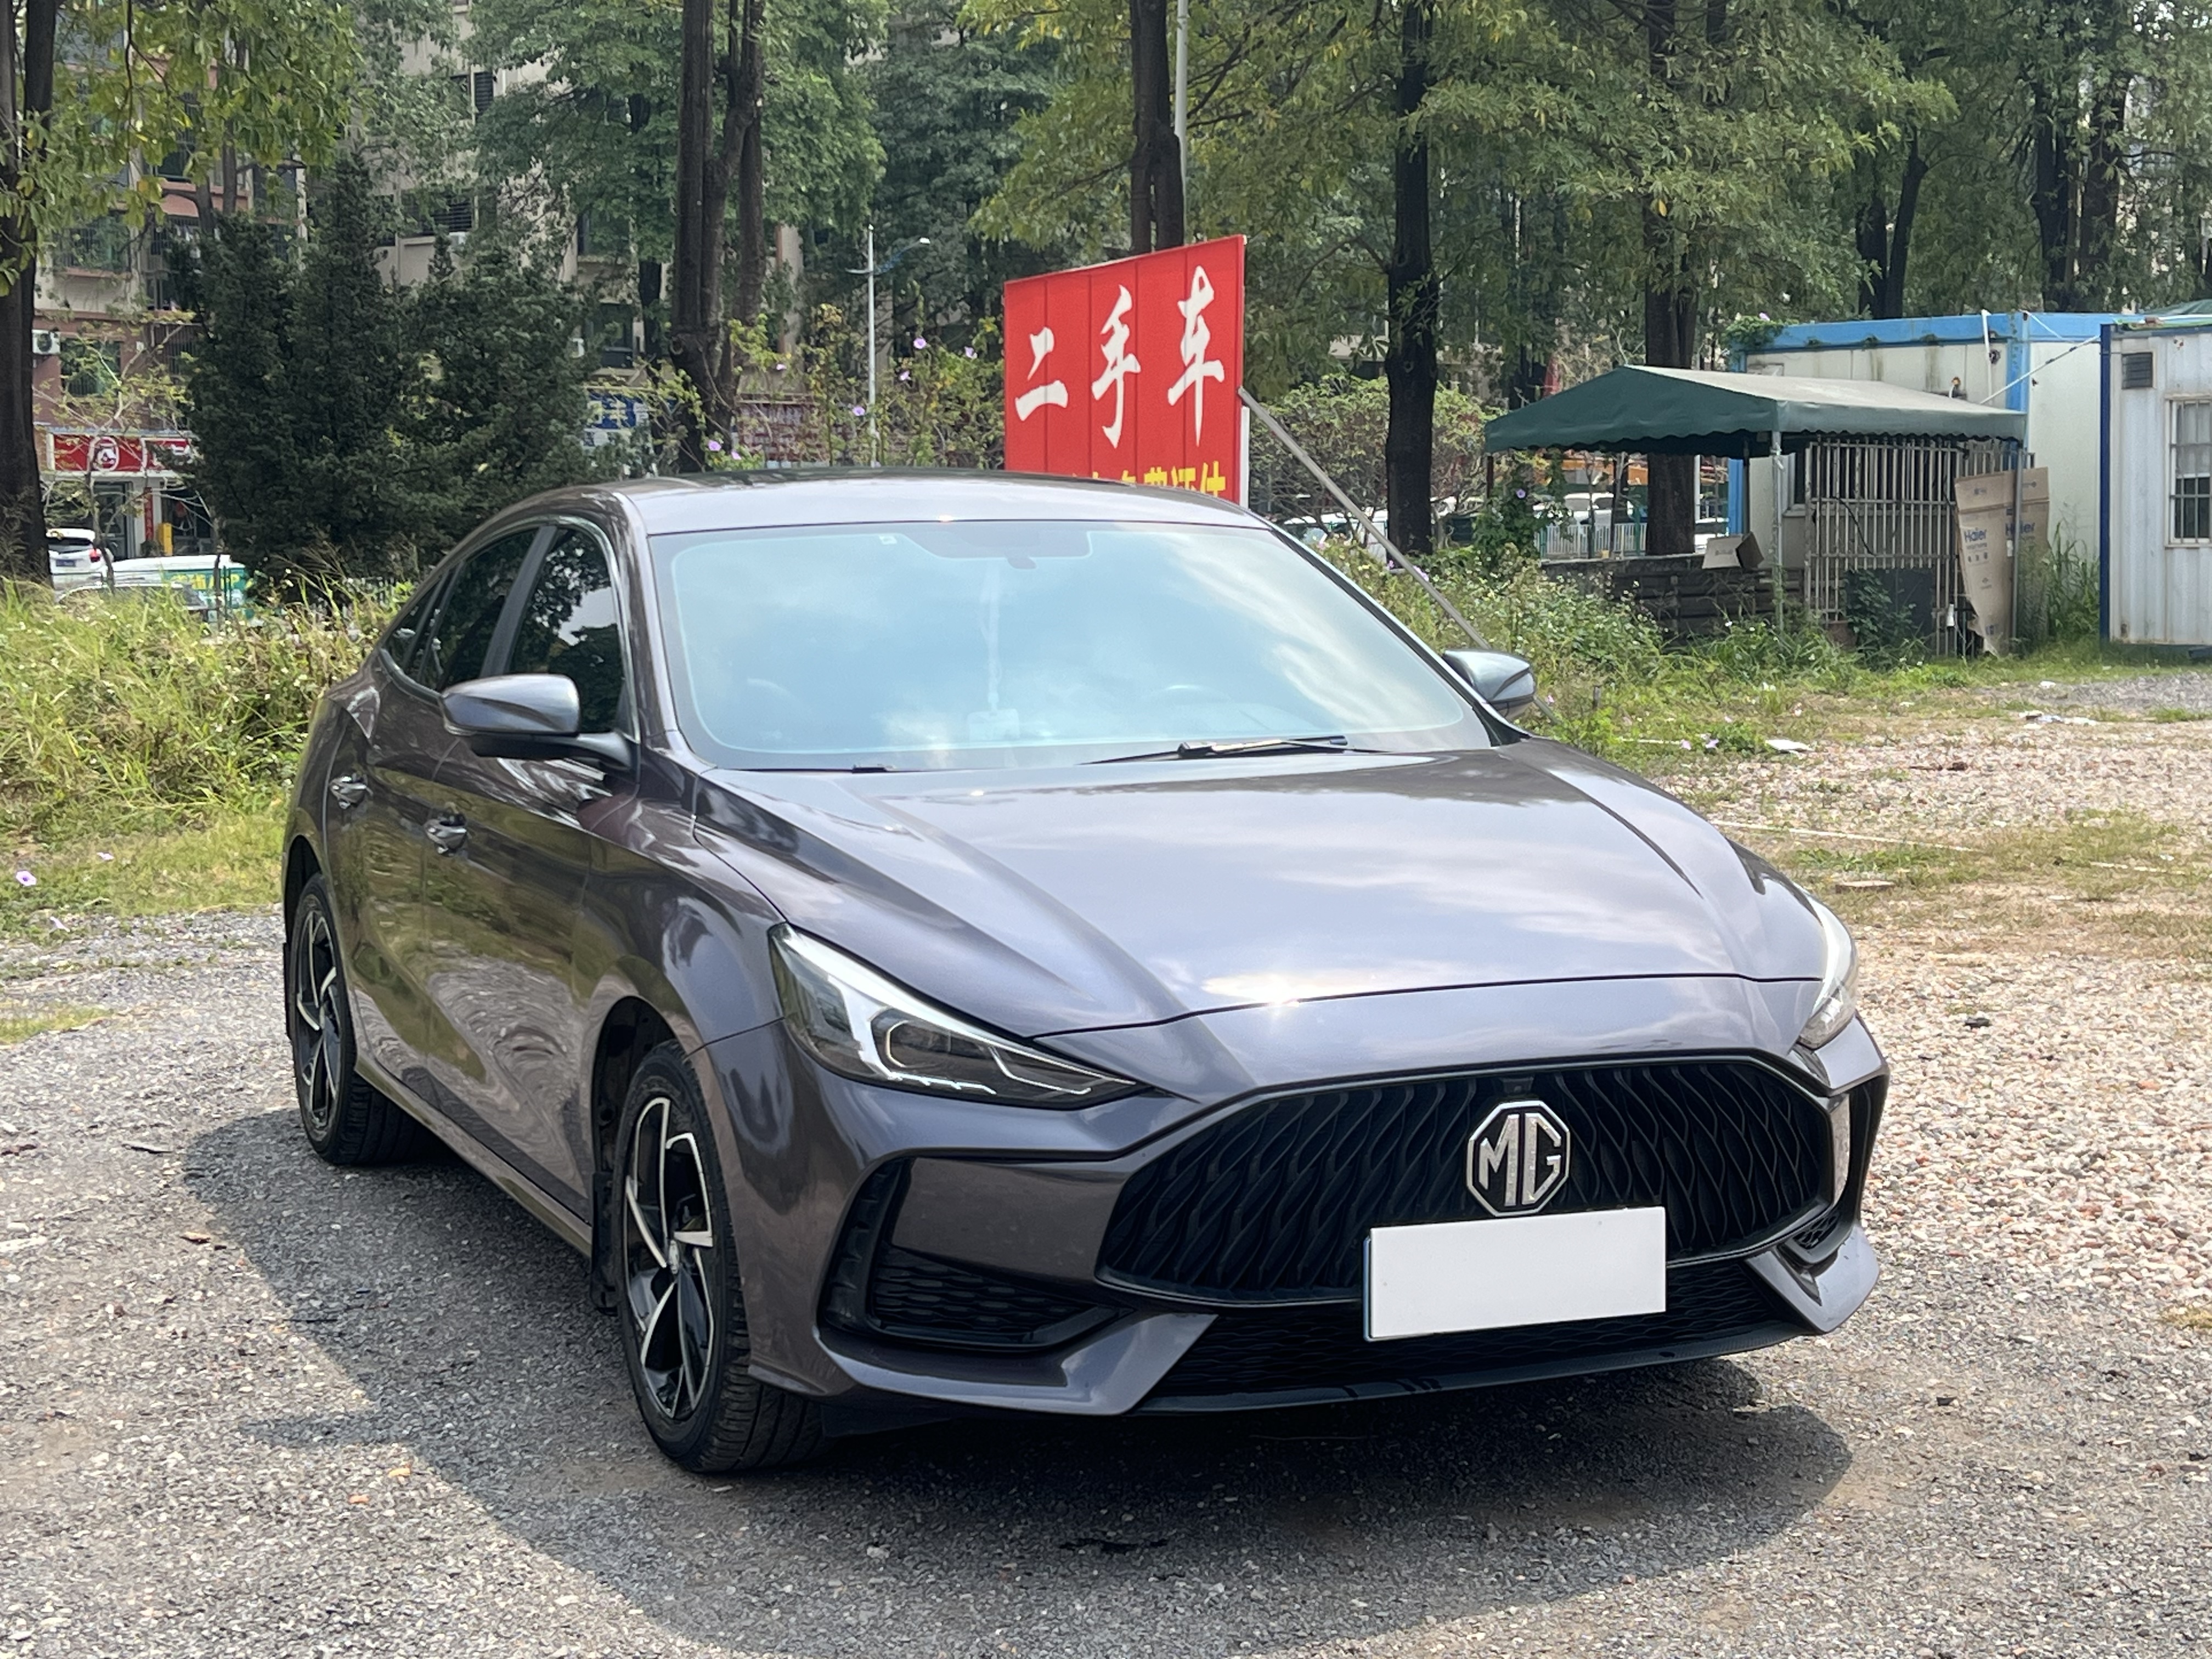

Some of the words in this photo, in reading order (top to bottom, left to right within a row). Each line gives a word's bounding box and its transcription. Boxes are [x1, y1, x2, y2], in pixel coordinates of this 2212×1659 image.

[1014, 265, 1225, 449] 二手车
[1964, 527, 1987, 543] Haier
[1479, 1112, 1562, 1206] MG
